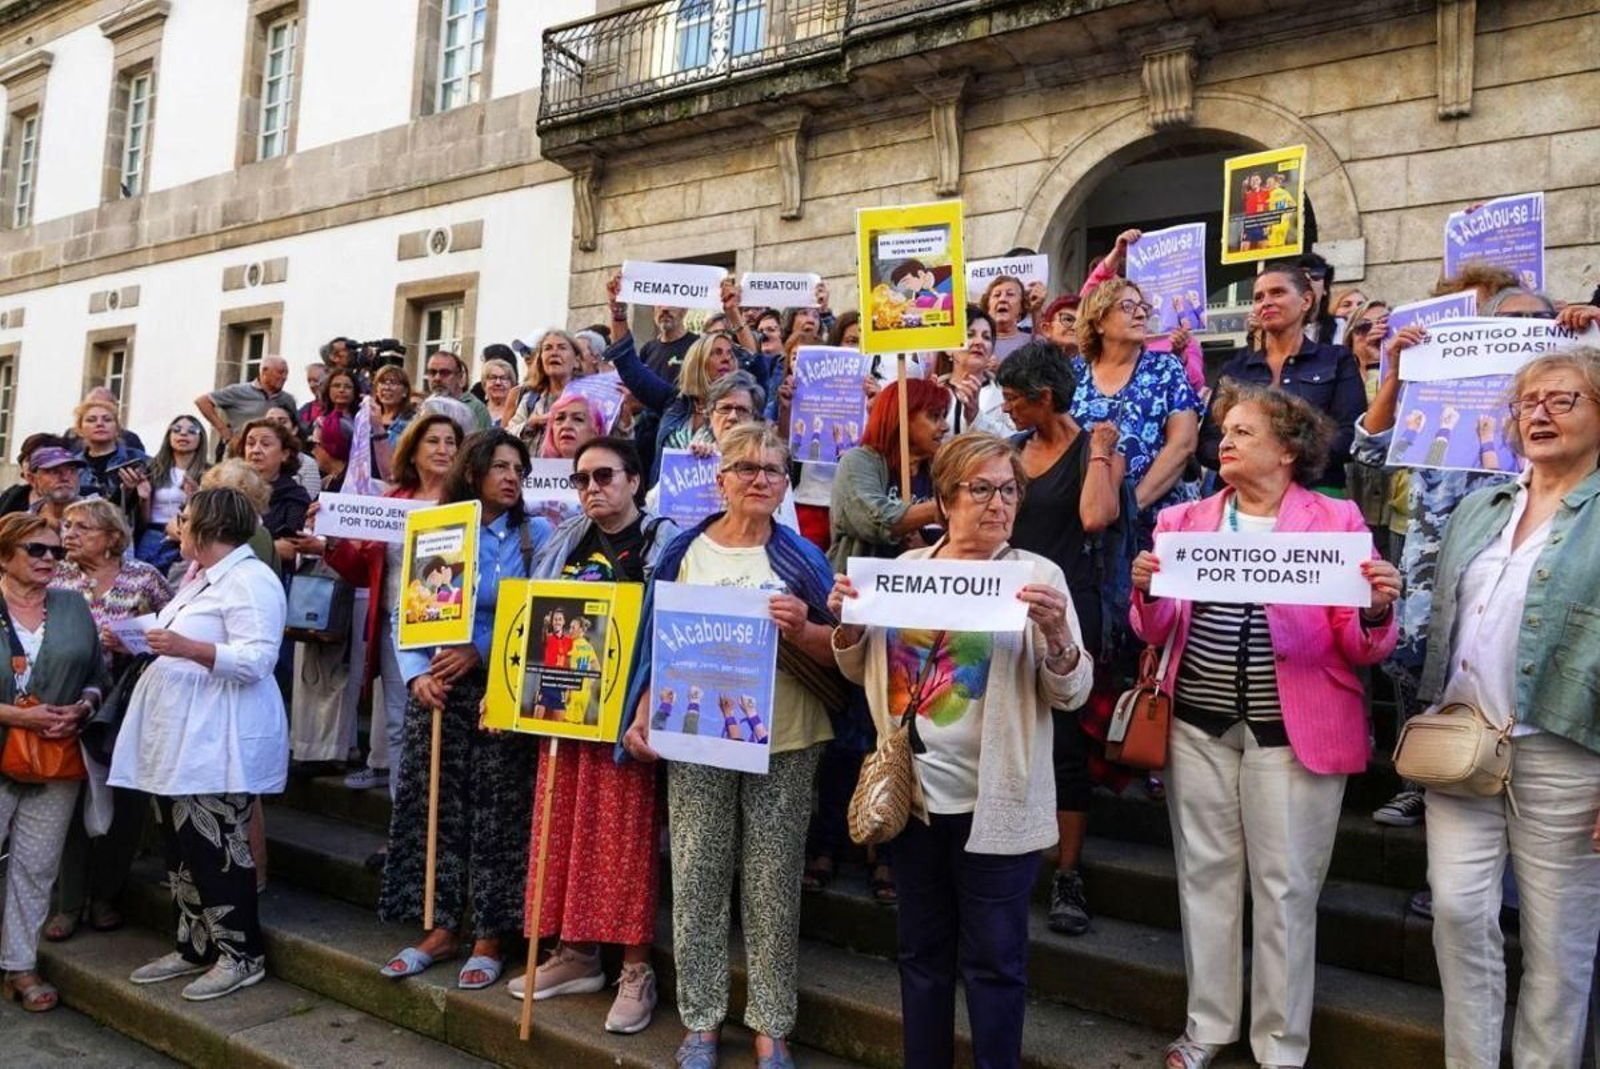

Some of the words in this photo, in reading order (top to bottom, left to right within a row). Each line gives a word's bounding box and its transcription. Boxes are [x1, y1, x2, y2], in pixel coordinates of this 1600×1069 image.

[971, 264, 1033, 278] REMATOU!!
[633, 281, 709, 298] REMATOU!!
[750, 280, 808, 291] REMATOU!!
[1423, 335, 1432, 345] #
[1437, 327, 1517, 344] CONTIGO
[1522, 325, 1579, 341] JENNI,
[1442, 346, 1479, 358] POR
[1486, 341, 1557, 354] TODAS!!
[337, 504, 383, 518] CONTIGO
[386, 508, 406, 519] JEN
[340, 516, 361, 528] POR
[364, 519, 405, 531] TODAS!!
[1176, 548, 1186, 562] #
[1191, 548, 1276, 563] CONTIGO
[1282, 549, 1345, 566] JENNI,
[1197, 568, 1235, 582] POR
[1242, 568, 1320, 584] TODAS!!
[876, 574, 1000, 597] REMATOU!!
